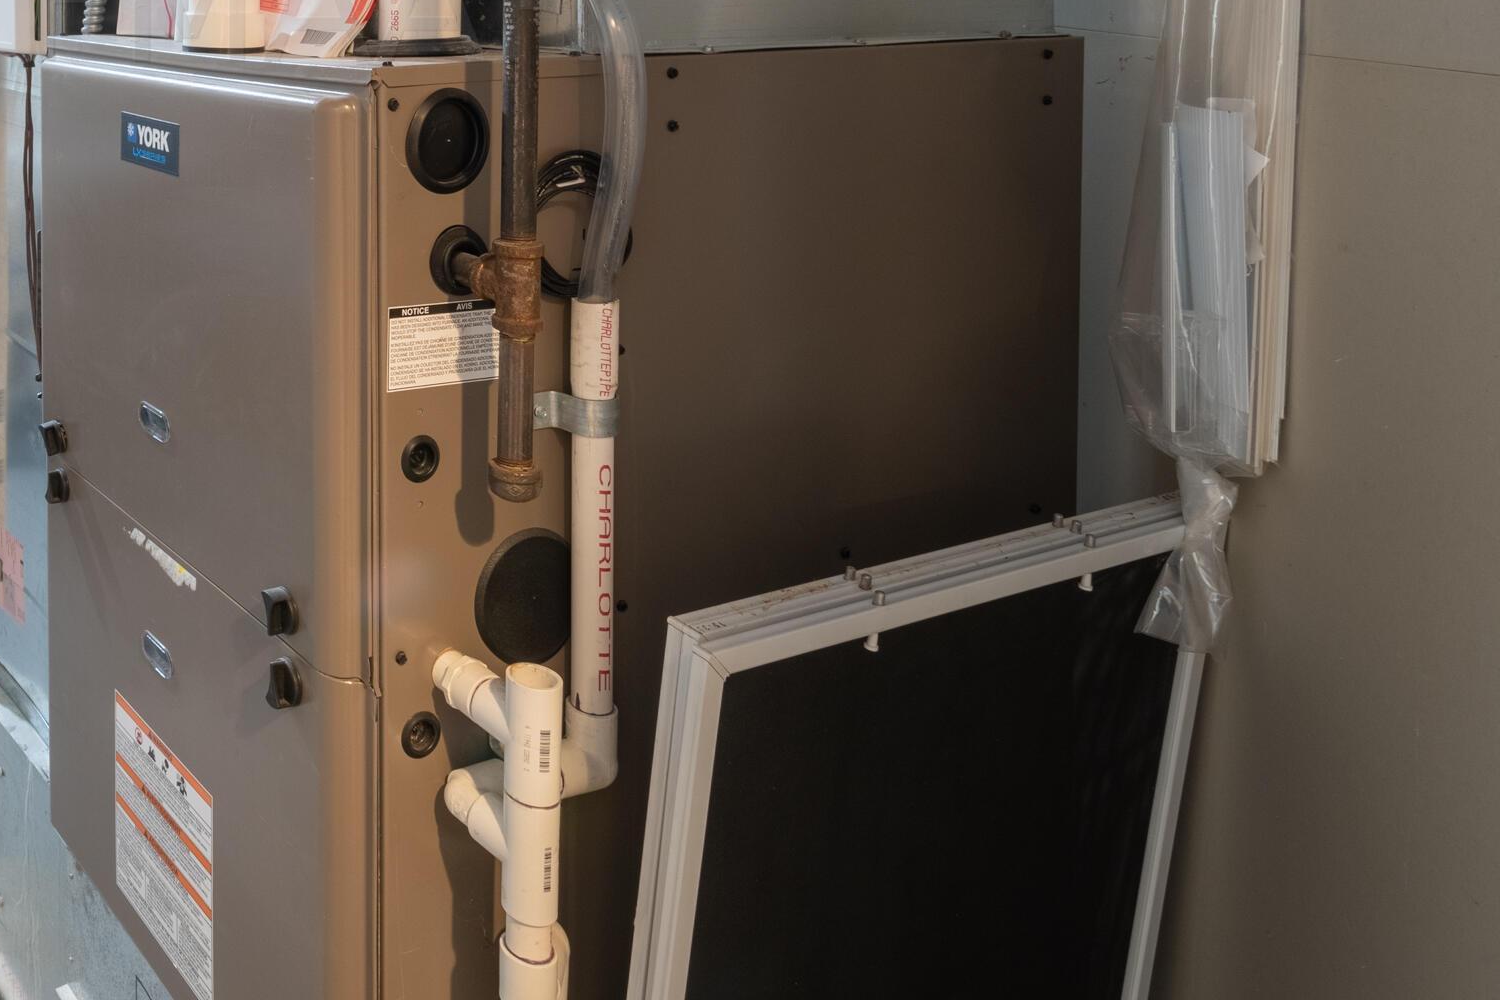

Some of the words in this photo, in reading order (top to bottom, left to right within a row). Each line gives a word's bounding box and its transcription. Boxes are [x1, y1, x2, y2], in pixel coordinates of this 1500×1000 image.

[390, 9, 400, 32] 2665
[137, 124, 170, 152] YORK
[401, 307, 430, 316] NOTICE
[456, 302, 473, 311] AVIS
[598, 464, 612, 692] CHARLOTTE
